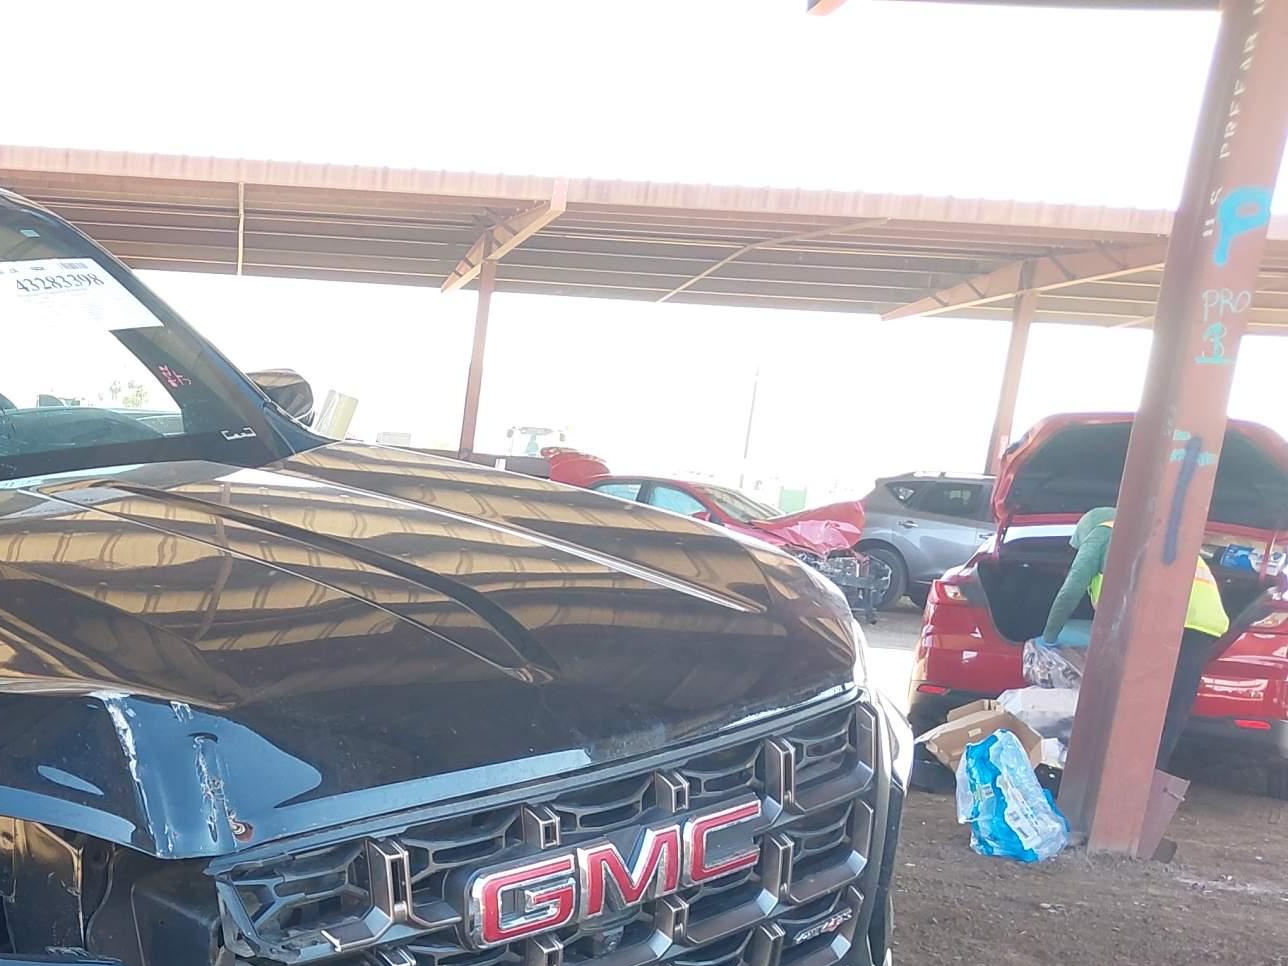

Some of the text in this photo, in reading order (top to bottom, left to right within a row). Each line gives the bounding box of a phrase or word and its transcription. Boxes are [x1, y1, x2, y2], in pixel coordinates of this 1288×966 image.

[1213, 185, 1273, 266] P
[15, 273, 105, 294] 43283398
[471, 800, 762, 950] GMC
